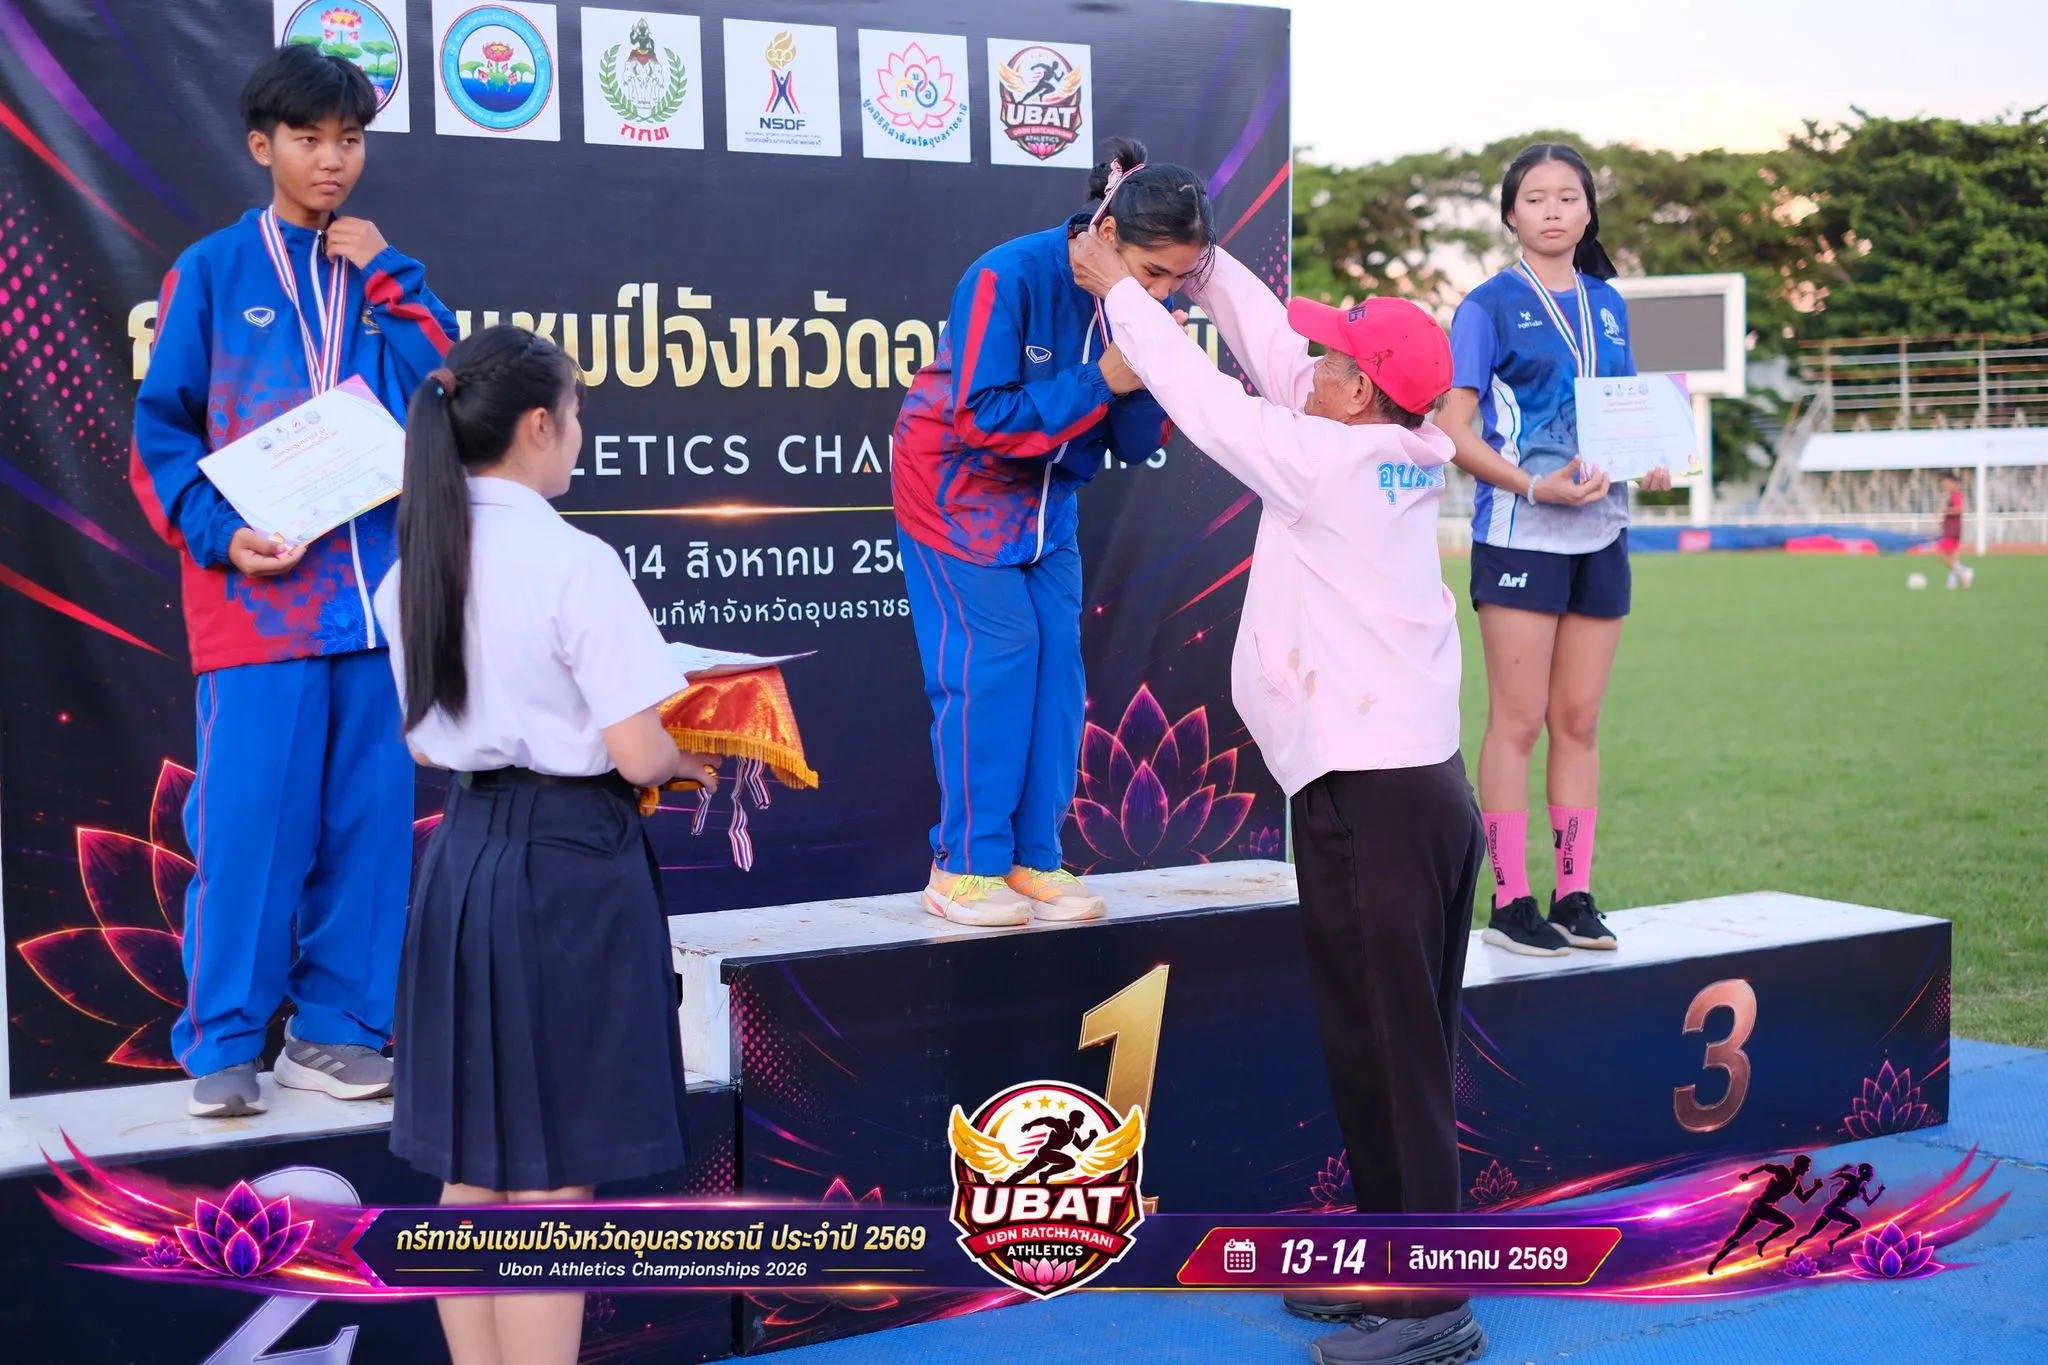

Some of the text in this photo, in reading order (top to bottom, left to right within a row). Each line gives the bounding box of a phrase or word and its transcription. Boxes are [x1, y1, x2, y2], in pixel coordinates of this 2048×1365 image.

[760, 117, 806, 131] NSDF
[1006, 103, 1078, 129] UBAT
[778, 434, 893, 475] CHA
[686, 541, 834, 579] สิงหาคม
[1498, 572, 1528, 588] Ari
[1673, 978, 1757, 1133] 3
